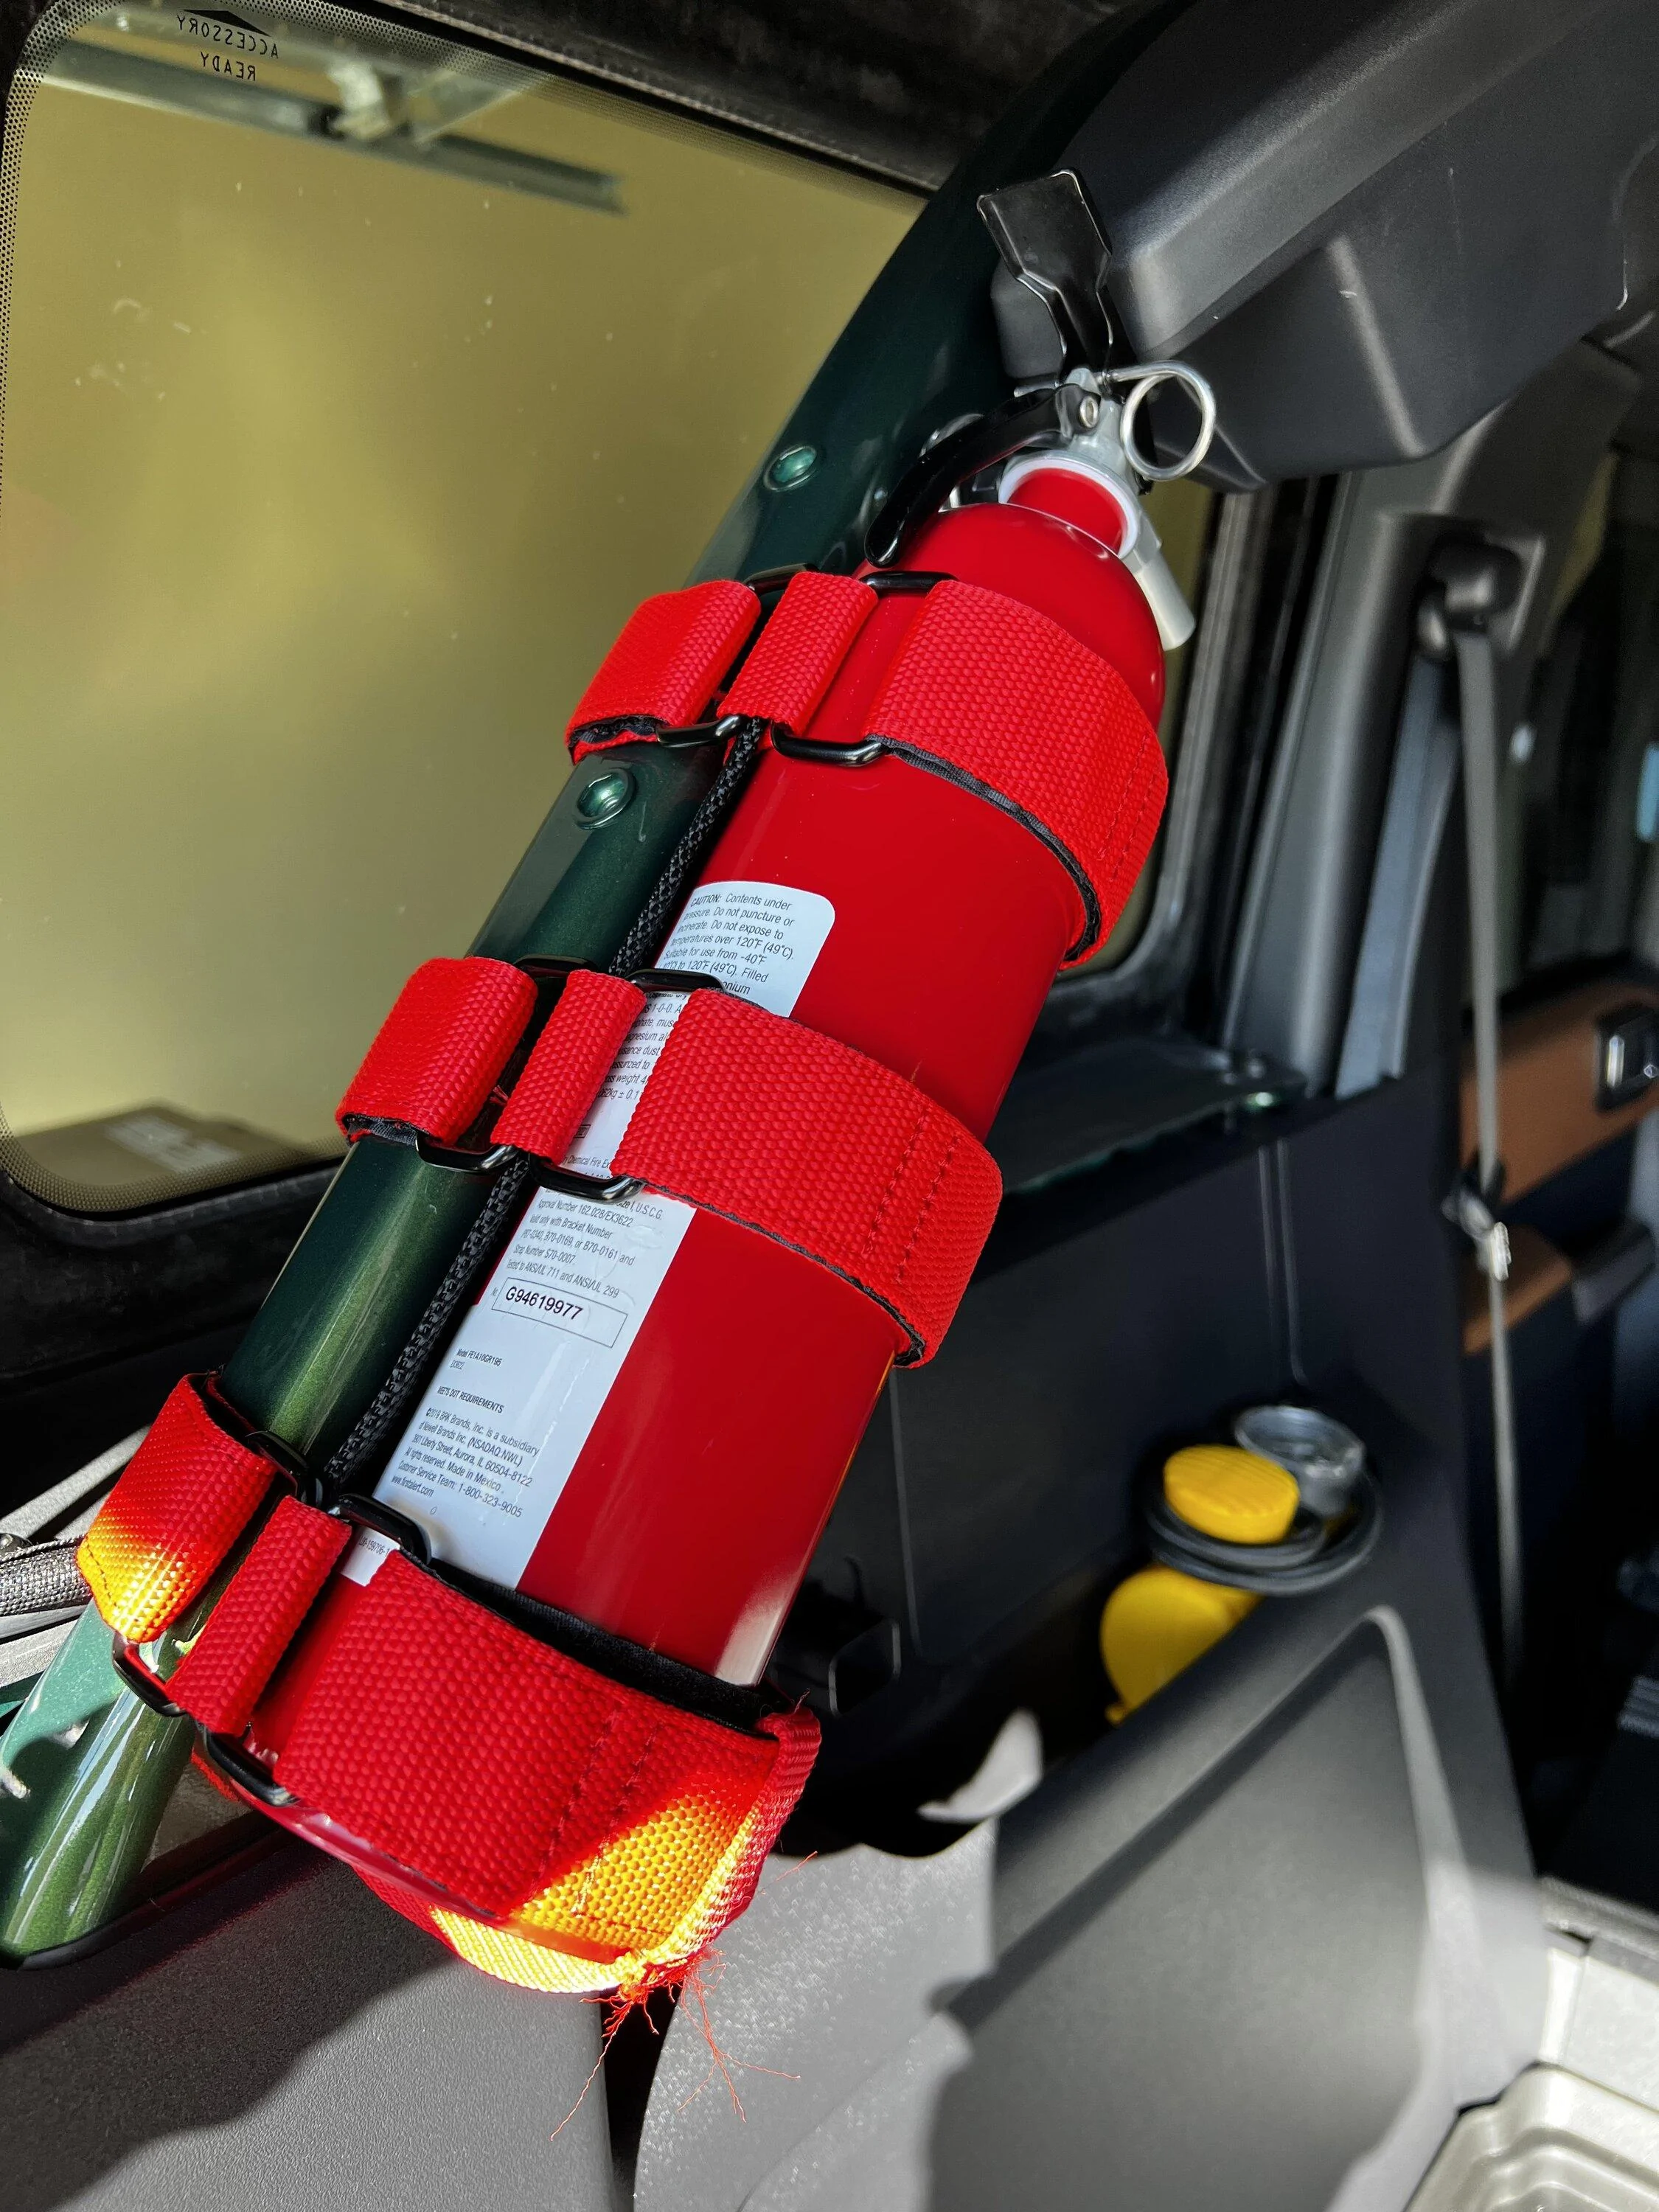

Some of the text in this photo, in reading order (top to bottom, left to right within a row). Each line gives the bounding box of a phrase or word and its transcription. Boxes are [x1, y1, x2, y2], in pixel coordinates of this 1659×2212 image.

[691, 893, 793, 911] CAUTION: Contents under
[714, 906, 723, 916] Do
[726, 908, 740, 917] not
[741, 909, 782, 923] puncture
[783, 918, 795, 927] or
[711, 919, 723, 929] Do
[725, 921, 738, 931] not
[739, 924, 772, 937] expose
[773, 929, 784, 940] to
[671, 934, 794, 961] temperatures over 120°F (49°C).
[689, 947, 700, 956] for
[700, 949, 714, 957] use
[717, 948, 737, 959] from
[741, 953, 768, 965] -40°F
[678, 961, 686, 970] to
[687, 960, 712, 970] 120°F
[741, 967, 769, 984] Filled
[723, 980, 751, 995] onium
[642, 1045, 660, 1055] dust
[641, 1059, 650, 1069] to
[616, 1074, 640, 1085] weight
[590, 1156, 601, 1166] Fire
[556, 1200, 577, 1211] Number
[578, 1204, 634, 1228] 162.028/EX3622
[550, 1217, 562, 1226] with
[562, 1218, 585, 1232] Bracket
[587, 1222, 613, 1239] Number
[525, 1245, 545, 1256] Number
[575, 1240, 583, 1248] or
[582, 1241, 619, 1260] B70-0161
[619, 1252, 636, 1266] and
[524, 1262, 546, 1276] ANSI/UL
[546, 1267, 560, 1279] 711
[560, 1272, 574, 1283] and
[573, 1272, 602, 1293] ANSI/UL
[602, 1285, 620, 1298] 299
[505, 1286, 583, 1320] G94619977
[449, 1388, 459, 1398] DOT
[459, 1391, 504, 1413] REQUIREMENTS
[423, 1422, 438, 1433] Newell
[437, 1425, 456, 1440] Brands
[455, 1432, 467, 1444] Inc.
[467, 1436, 524, 1467] (NSADAQ:NWL)
[439, 1411, 452, 1422] BRK
[451, 1414, 470, 1430] Brands,
[473, 1422, 484, 1434] Inc.
[486, 1427, 493, 1438] is
[493, 1432, 500, 1440] a
[500, 1433, 540, 1458] subsidiary
[421, 1436, 435, 1451] Liberty
[436, 1441, 453, 1457] Street,
[453, 1447, 476, 1466] Aurora,
[477, 1456, 484, 1468] IL
[485, 1460, 533, 1487] 60504-8122
[421, 1453, 445, 1470] reserved.
[447, 1461, 466, 1477] Made
[465, 1468, 473, 1481] in
[398, 1460, 523, 1517] Customer Service Team: 1-800-323-9005
